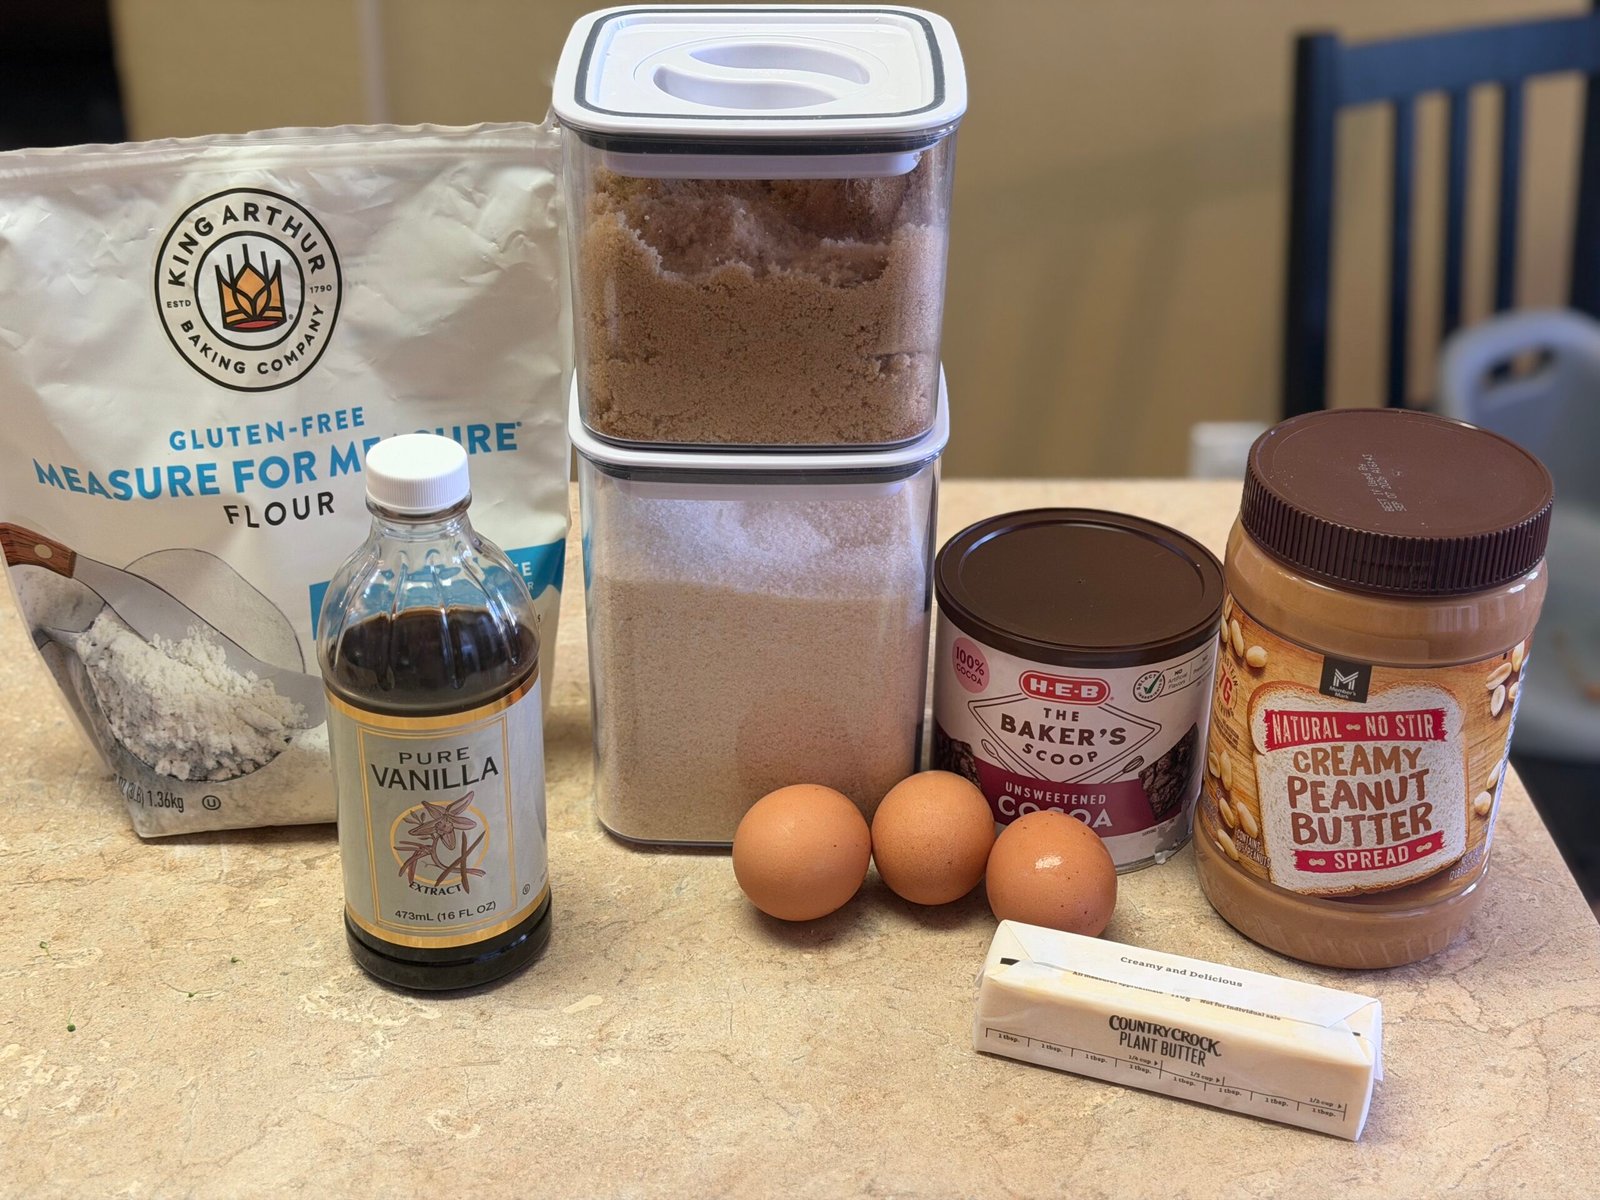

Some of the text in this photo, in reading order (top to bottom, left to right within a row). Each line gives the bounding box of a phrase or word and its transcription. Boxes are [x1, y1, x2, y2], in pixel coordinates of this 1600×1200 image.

[167, 202, 326, 287] KING ARTHUR
[309, 284, 333, 294] 1790
[166, 299, 191, 309] ESTD
[180, 304, 325, 375] BAKING COMPANY
[169, 406, 365, 452] GLUTEN-FREE
[33, 457, 221, 501] MEASURE
[233, 449, 318, 494] FOR
[224, 491, 336, 529] FLOUR
[955, 645, 985, 677] 100%
[955, 662, 983, 687] COCOA
[1029, 677, 1100, 699] H-E-B
[1043, 707, 1080, 722] THE
[1000, 713, 1127, 747] BAKER'S
[1271, 713, 1343, 745] NATURAL
[1364, 714, 1390, 738] NO
[1395, 712, 1435, 740] STIR
[398, 746, 471, 765] PURE
[1021, 743, 1099, 766] SCOOP
[1292, 745, 1423, 777] CREAMY
[370, 756, 499, 791] VANILLA
[146, 790, 185, 814] 1.36kg
[1004, 781, 1107, 805] UNSWEETENED
[1286, 769, 1430, 814] PEANUT
[997, 795, 1113, 829] COOA
[1290, 802, 1434, 847] BUTTER
[1333, 845, 1410, 871] SPREAD
[409, 881, 462, 896] EXTRACT
[394, 901, 497, 923] 473mL (16 FL OZ)
[1119, 956, 1244, 988] Creamy and Delicious
[1214, 1001, 1226, 1009] for
[1226, 1004, 1265, 1018] individual
[1118, 1030, 1207, 1068] PLANT BUTTER
[1139, 1057, 1152, 1066] cup
[1201, 1074, 1214, 1083] cup
[1321, 1100, 1335, 1108] cup
